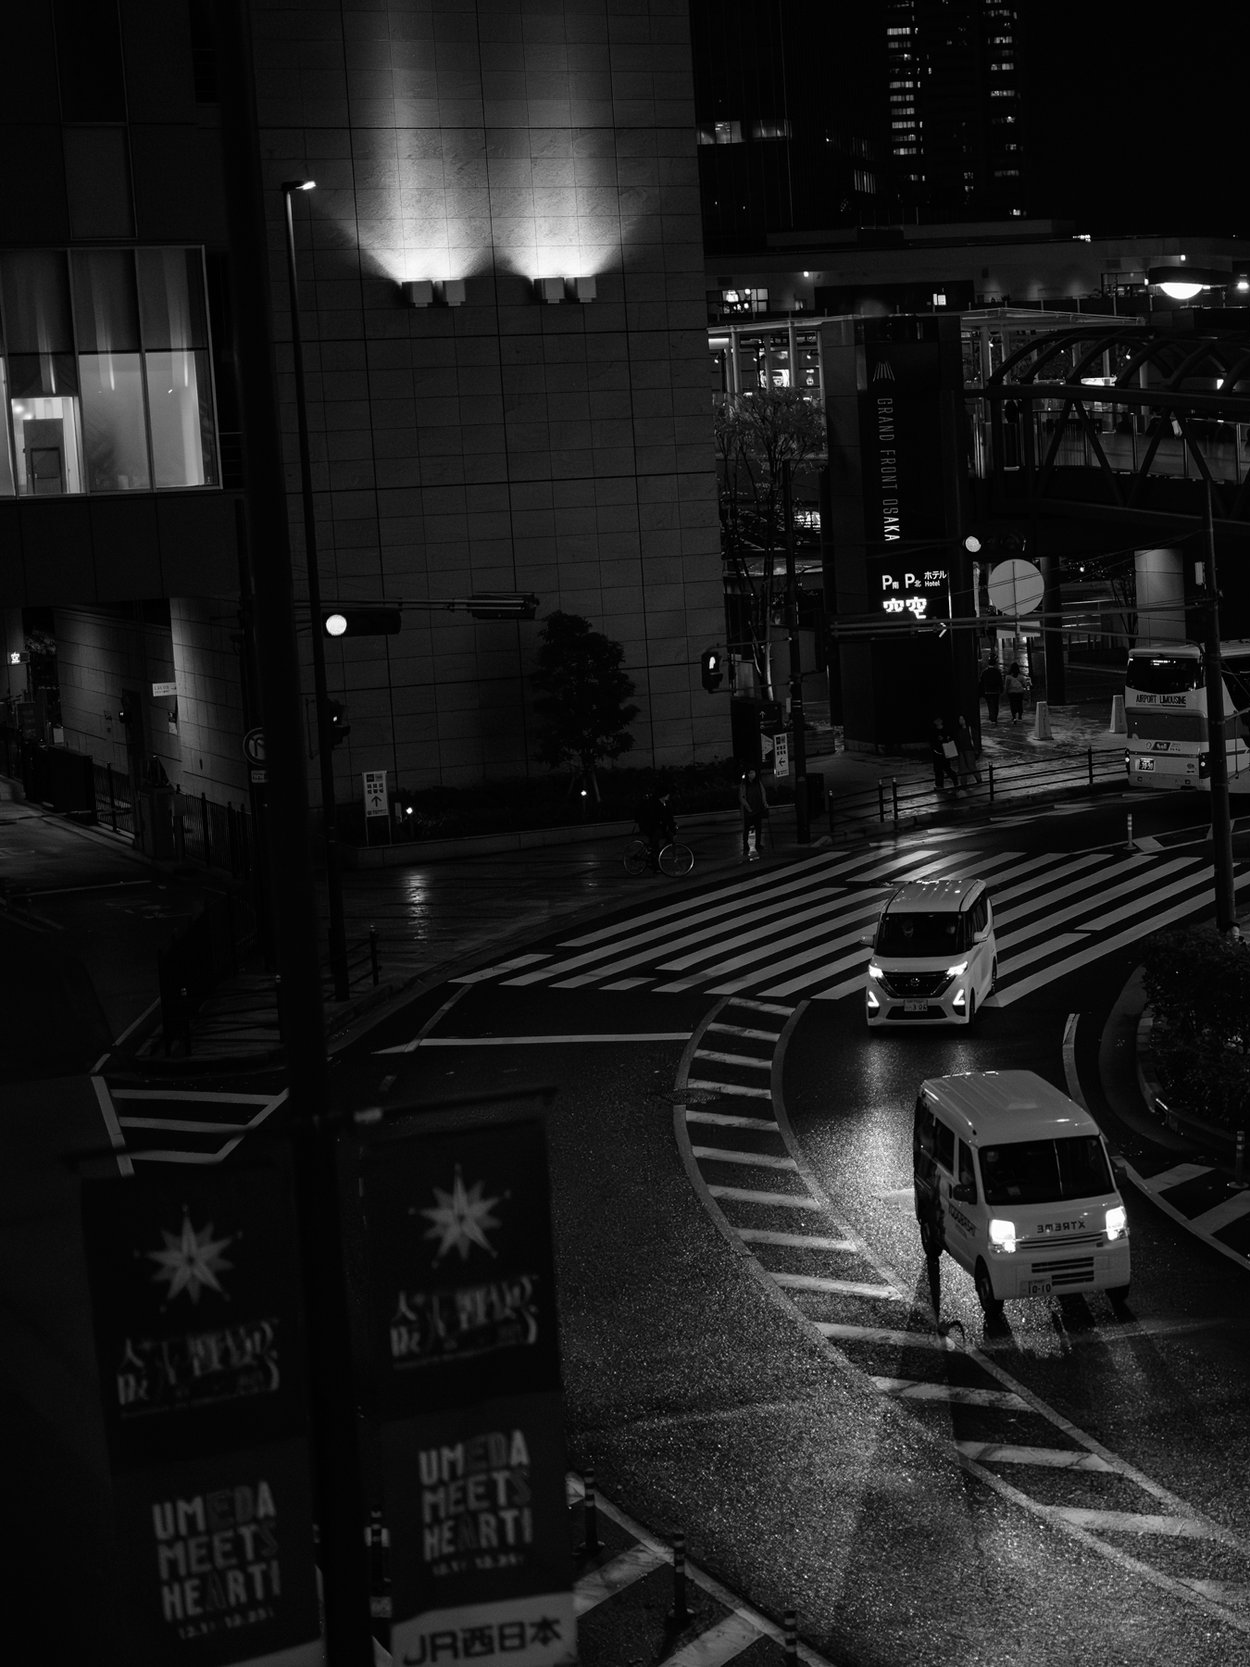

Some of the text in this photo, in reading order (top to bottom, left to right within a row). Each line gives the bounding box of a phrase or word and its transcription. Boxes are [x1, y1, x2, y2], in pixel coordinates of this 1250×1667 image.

[877, 398, 901, 542] GRAND FRONT OSAKA
[1136, 694, 1187, 705] AIRPORT LIMOUSINE
[418, 1428, 530, 1486] UMEDA
[152, 1480, 277, 1541] UMEDA
[421, 1468, 533, 1524] MEETS
[156, 1520, 280, 1581] MEETS
[402, 1615, 562, 1667] JR西日本
